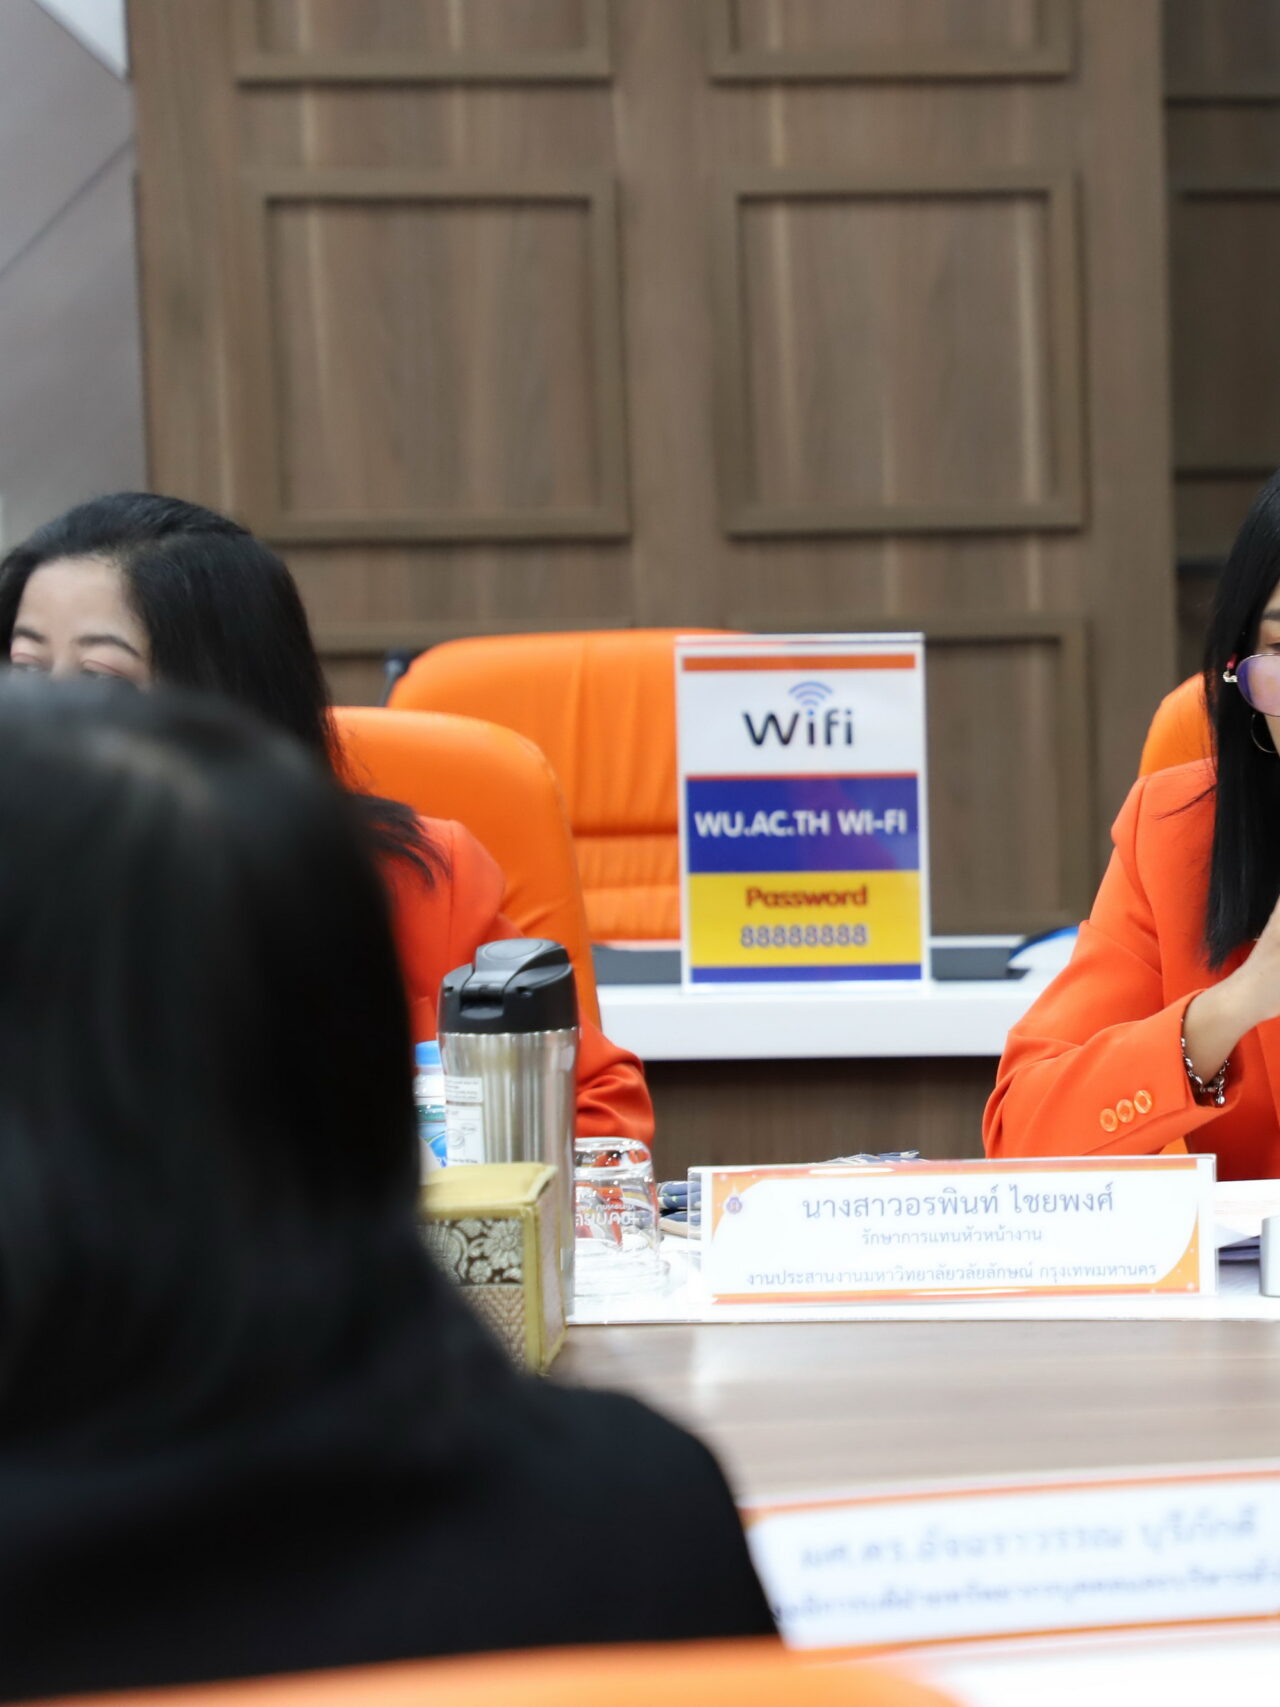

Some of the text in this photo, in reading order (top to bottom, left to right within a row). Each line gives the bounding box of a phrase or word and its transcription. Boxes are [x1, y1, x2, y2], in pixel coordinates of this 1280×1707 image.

[743, 707, 855, 746] Wifi
[694, 809, 908, 838] WU.AC.TH WI-FI
[745, 884, 869, 910] Password
[740, 924, 868, 949] 88888888
[801, 1180, 1115, 1220] นางสาวอรพินท์ ไชยพงศ์
